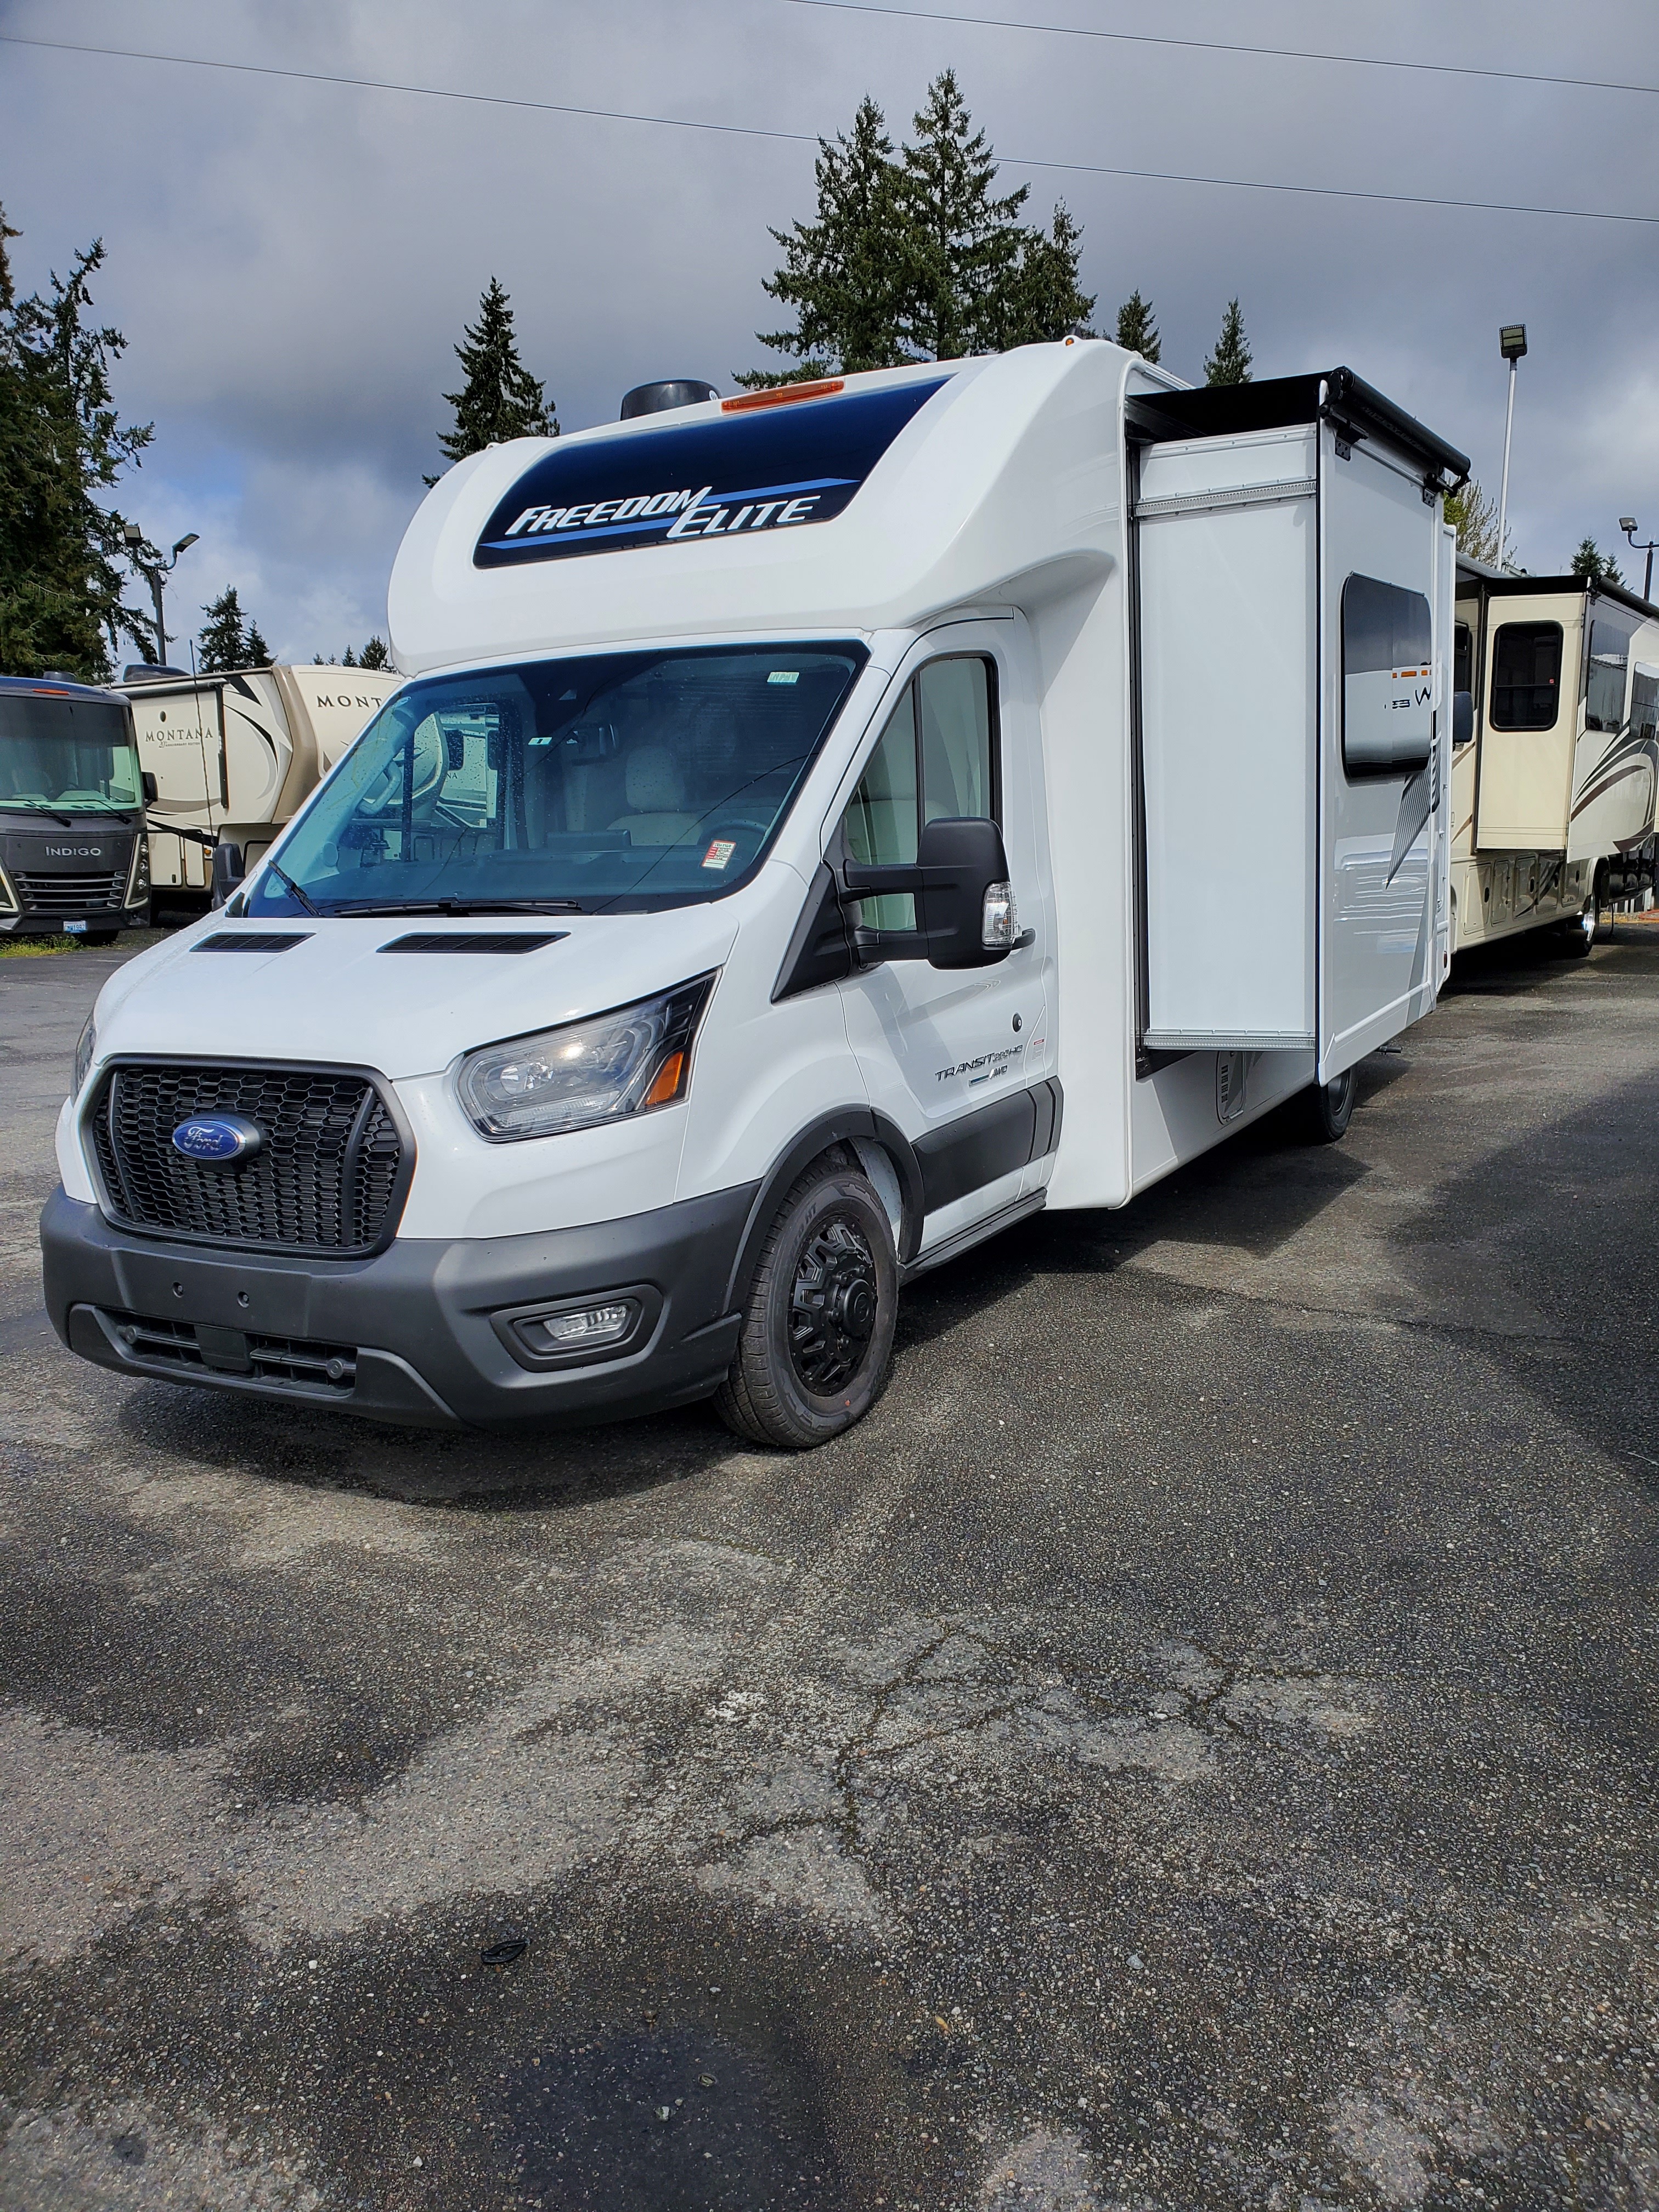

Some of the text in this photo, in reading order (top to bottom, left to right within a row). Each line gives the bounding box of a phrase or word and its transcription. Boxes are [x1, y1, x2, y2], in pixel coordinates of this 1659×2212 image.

[505, 486, 821, 538] FREEDOM ELITE
[317, 695, 382, 708] MONT
[145, 727, 213, 742] MONTANA
[45, 846, 101, 856] INDIGO
[935, 1052, 995, 1081] TRANSIT
[989, 1065, 1008, 1080] AWD
[184, 1126, 224, 1151] Ford
